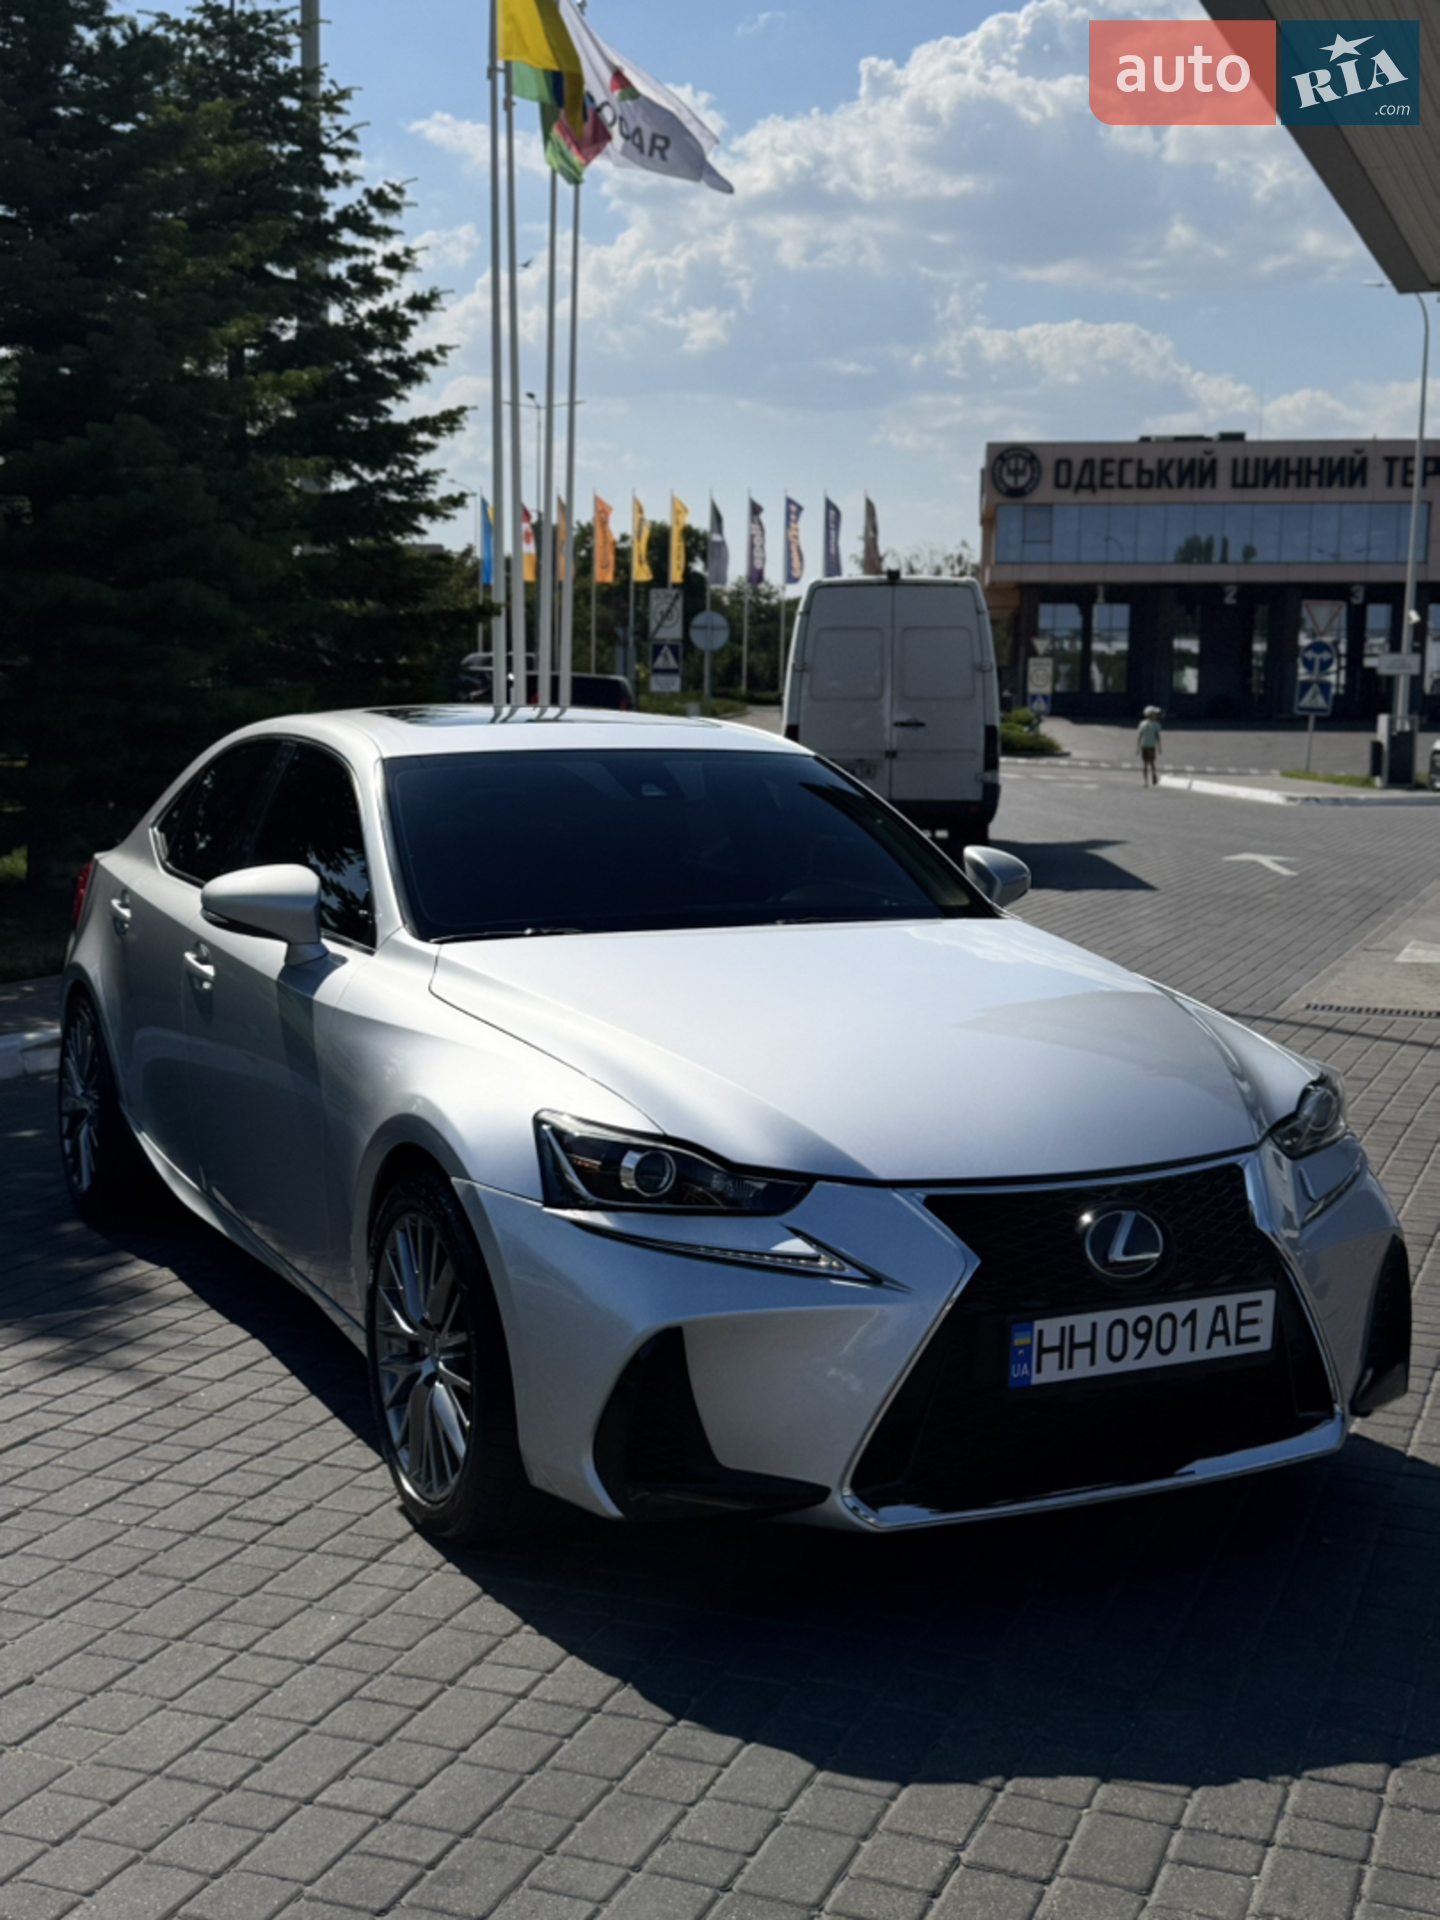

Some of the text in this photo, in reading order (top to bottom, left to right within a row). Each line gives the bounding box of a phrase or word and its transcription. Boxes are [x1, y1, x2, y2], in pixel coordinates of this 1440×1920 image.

[1054, 449, 1218, 495] ОДЕСЬКИЙ
[1231, 448, 1368, 489] ШИННИЙ
[1096, 584, 1105, 603] 1
[1224, 584, 1238, 604] 2
[1351, 584, 1365, 604] 3
[1012, 1364, 1029, 1378] UA
